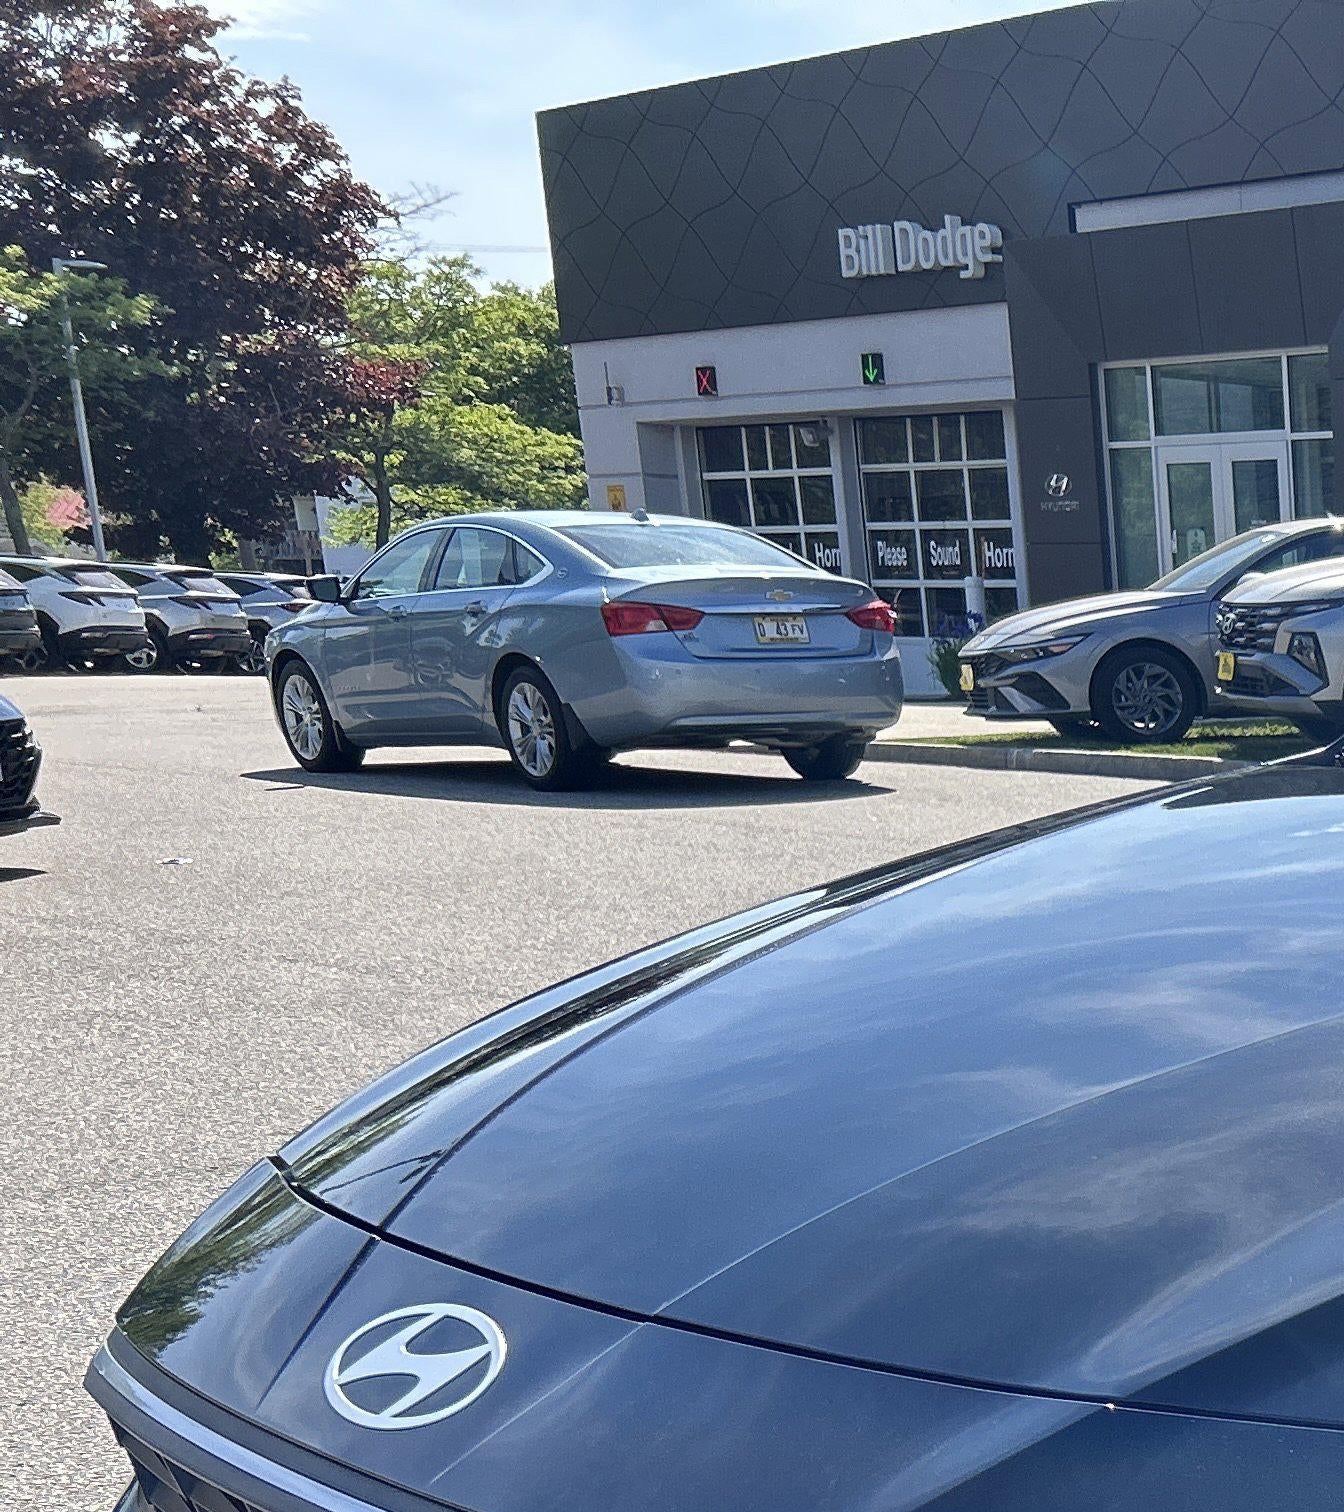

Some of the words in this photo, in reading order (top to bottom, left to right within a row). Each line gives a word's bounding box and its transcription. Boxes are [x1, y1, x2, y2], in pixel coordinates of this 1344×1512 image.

[838, 224, 896, 279] Bill
[893, 214, 1003, 279] Dodge
[877, 541, 908, 566] Please
[930, 539, 961, 567] Sound
[984, 541, 1015, 567] Horn
